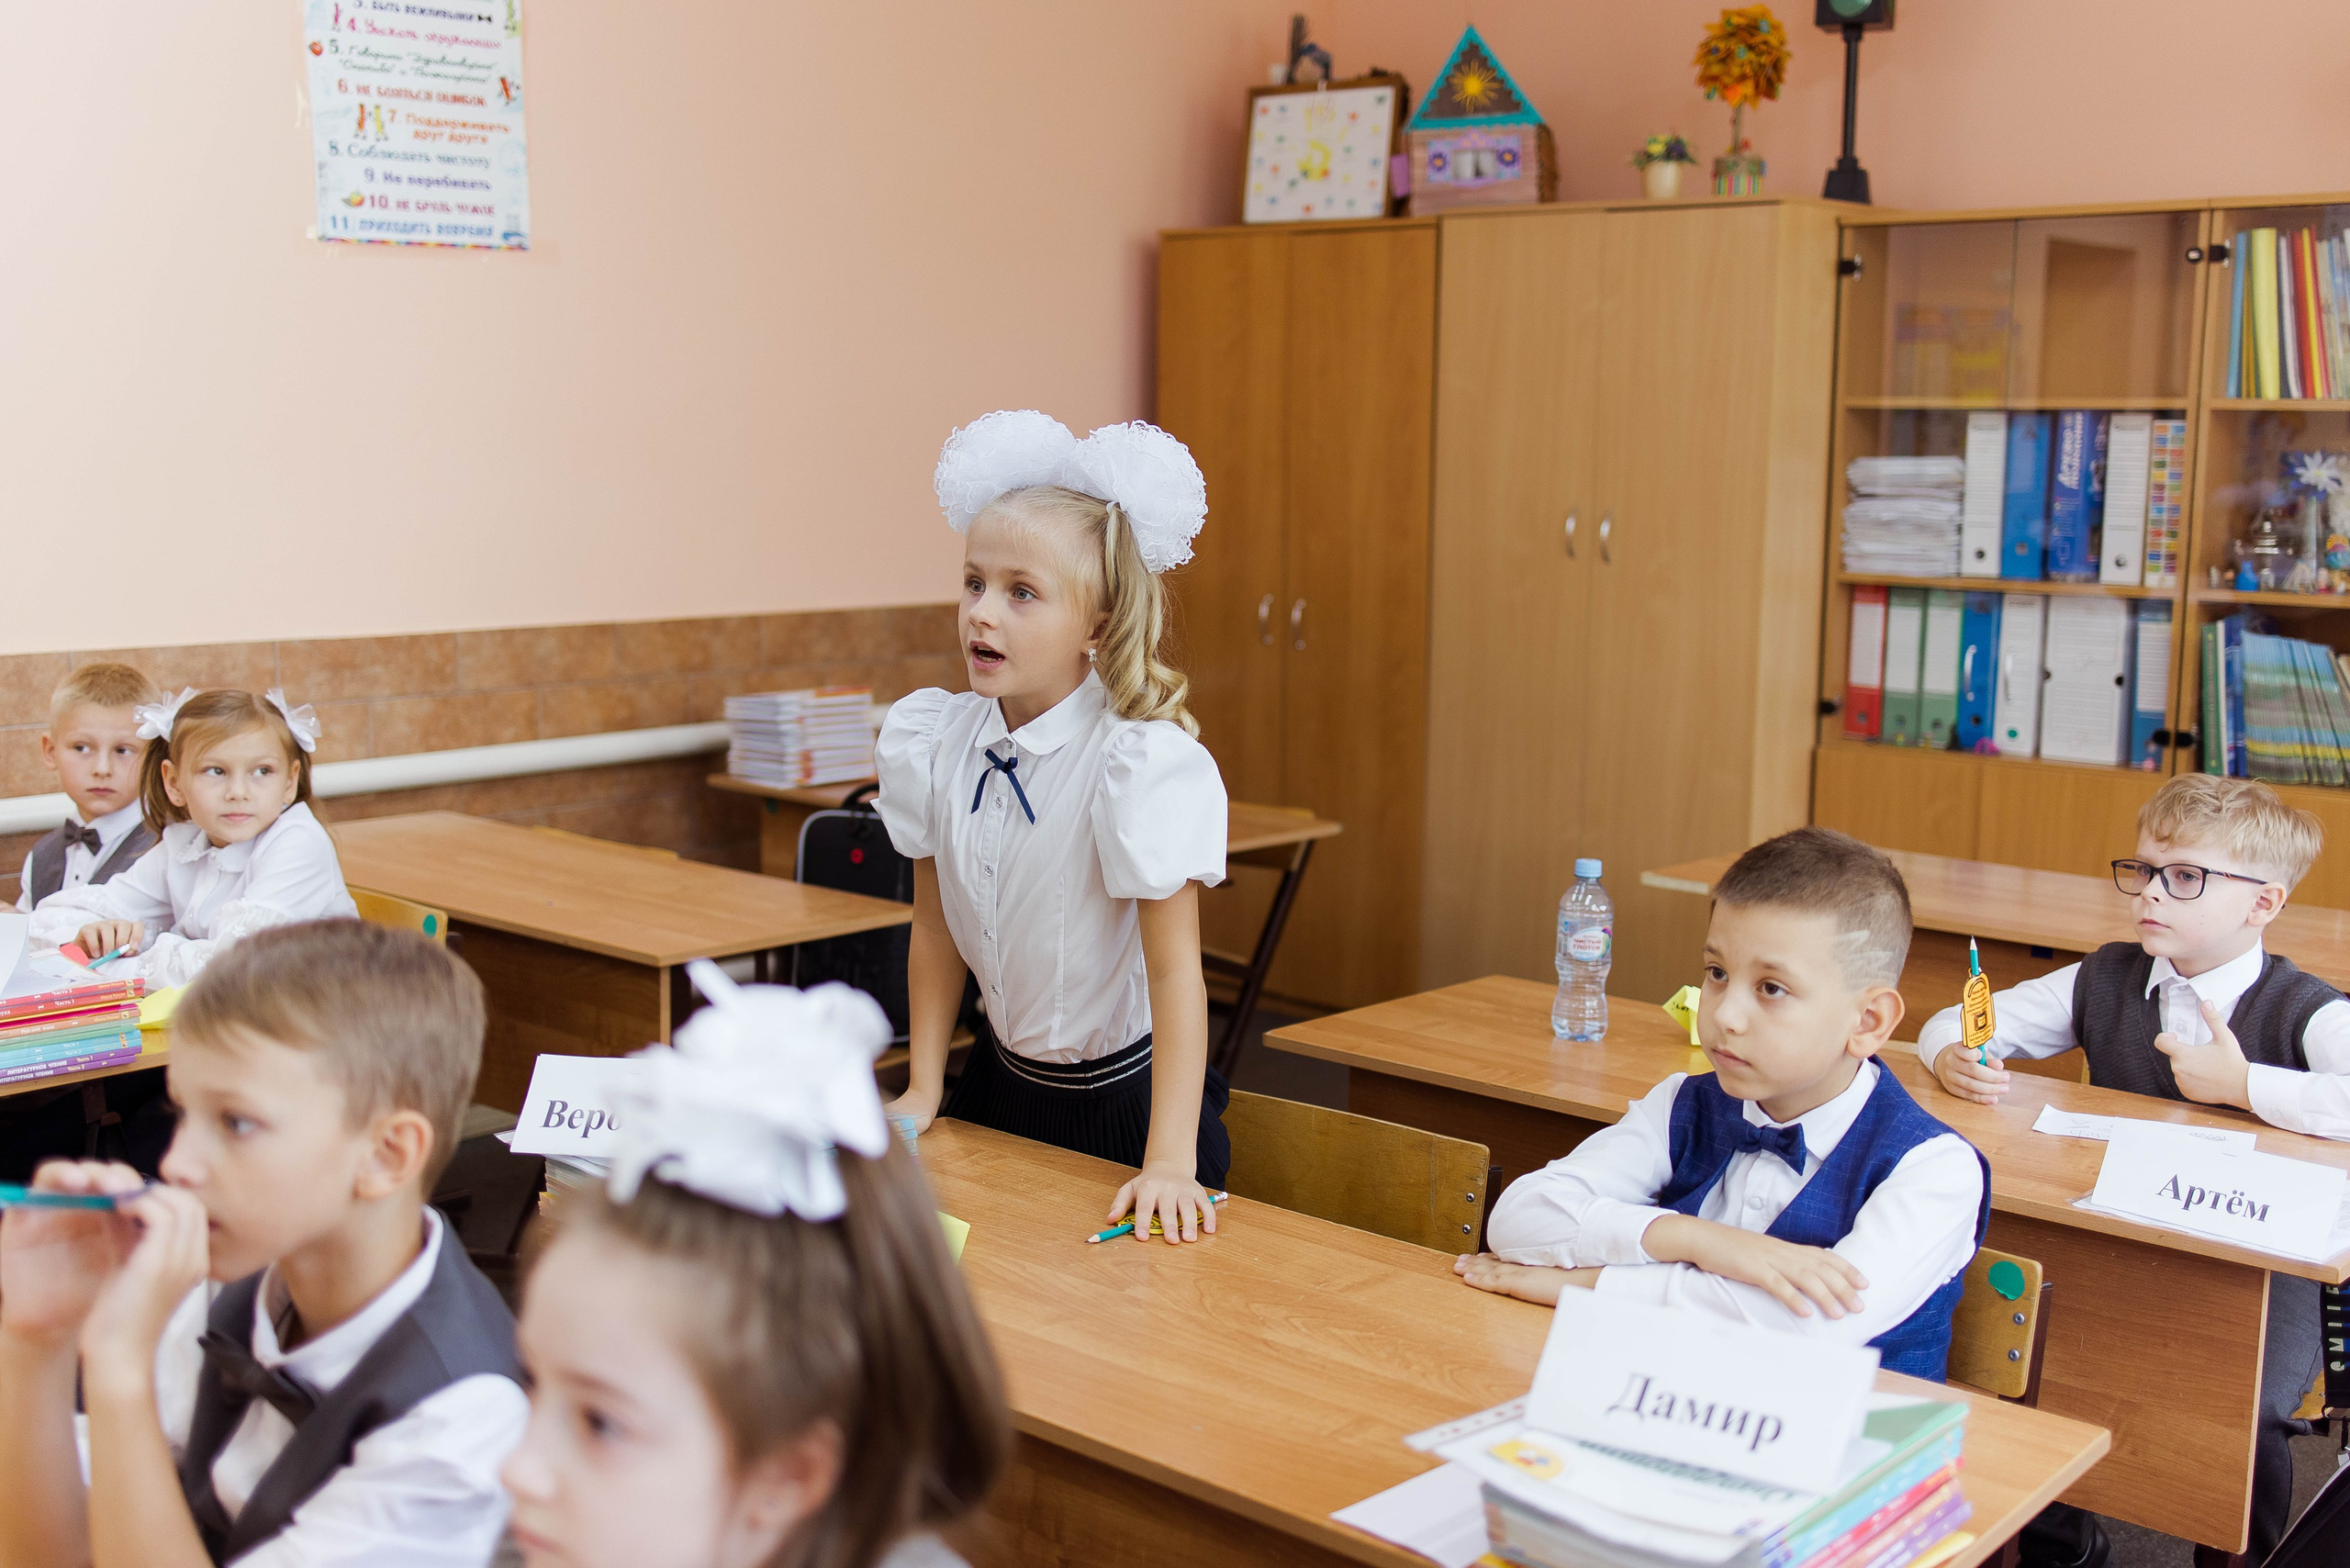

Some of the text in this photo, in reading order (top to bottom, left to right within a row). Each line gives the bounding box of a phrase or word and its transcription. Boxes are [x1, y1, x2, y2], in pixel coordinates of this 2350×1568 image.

[347, 143, 431, 162] Соблюдать
[408, 174, 492, 191] перебивать
[20, 1026, 40, 1035] Русский
[6, 1064, 48, 1076] ЛИТЕРАТУРНОЕ
[48, 1060, 68, 1070] ЧТЕНИЕ
[36, 1070, 54, 1078] ЧТЕНИЕ
[2155, 1173, 2271, 1222] Артём
[1606, 1372, 1784, 1451] Дамир
